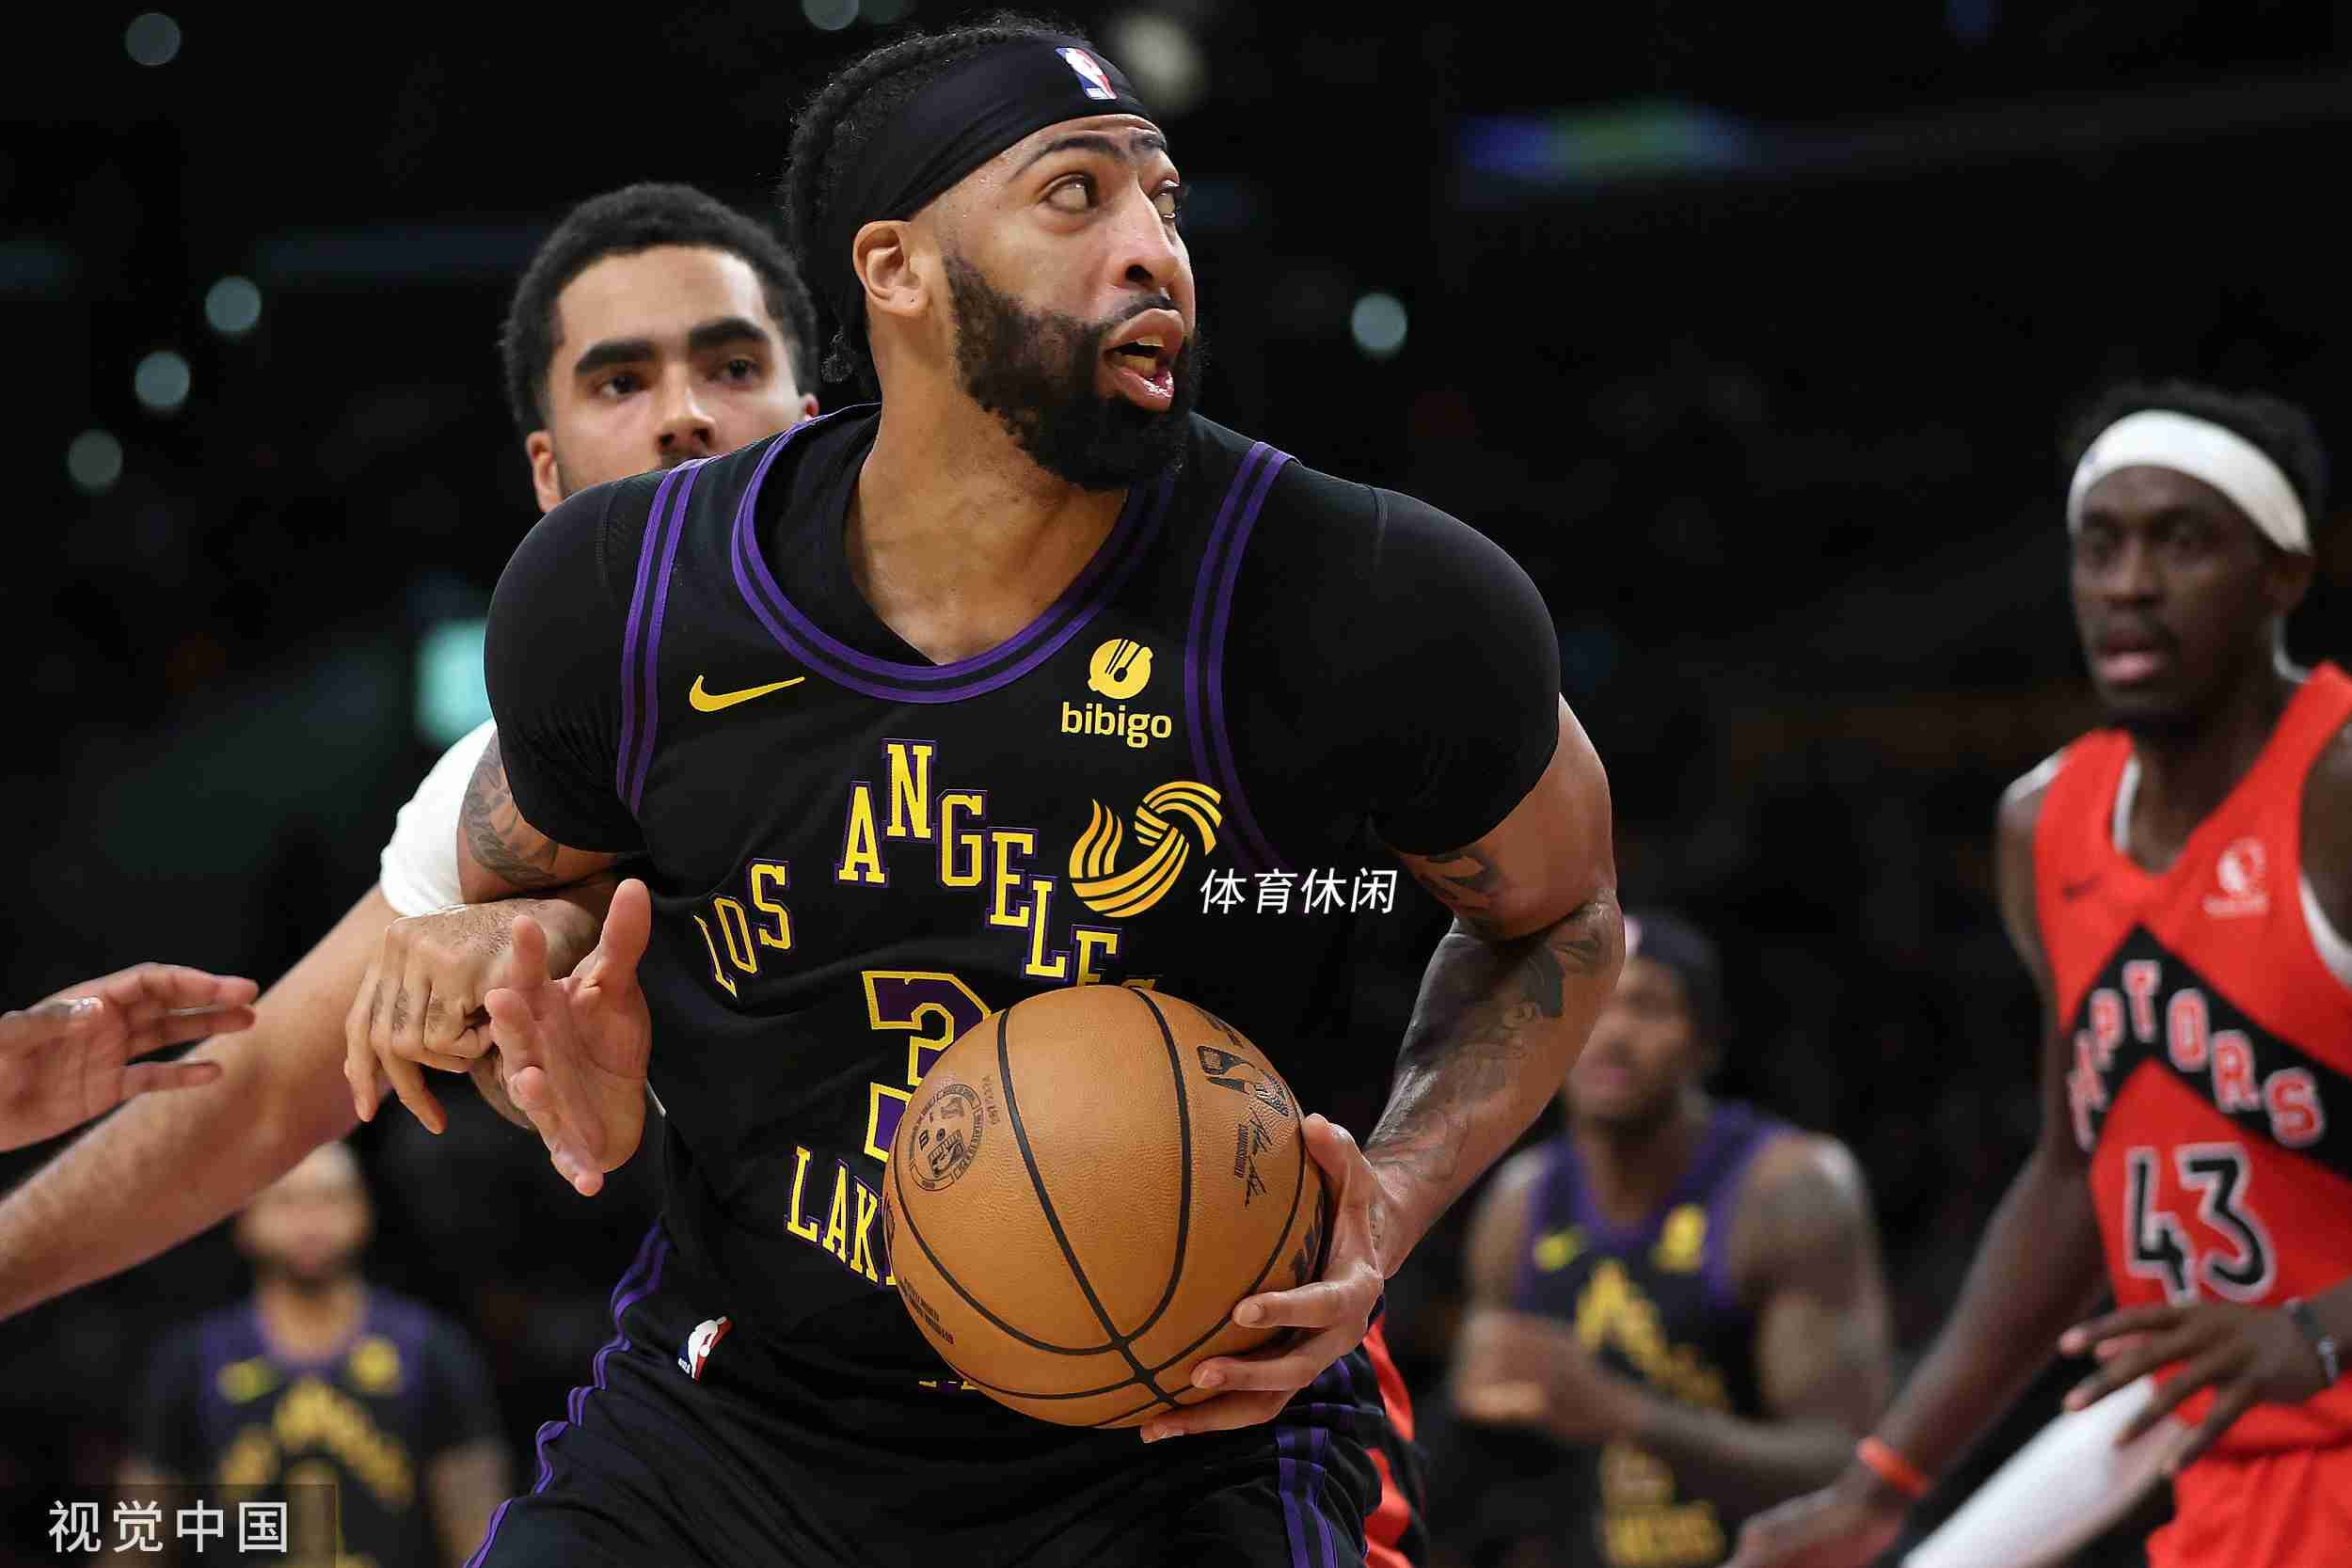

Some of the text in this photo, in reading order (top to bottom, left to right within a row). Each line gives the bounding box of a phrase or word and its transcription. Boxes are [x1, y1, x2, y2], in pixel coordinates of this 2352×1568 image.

[1061, 702, 1171, 748] bibigo
[692, 739, 1156, 999] LOS ANGELE
[787, 1146, 897, 1285] LAK
[2124, 1142, 2278, 1307] 43
